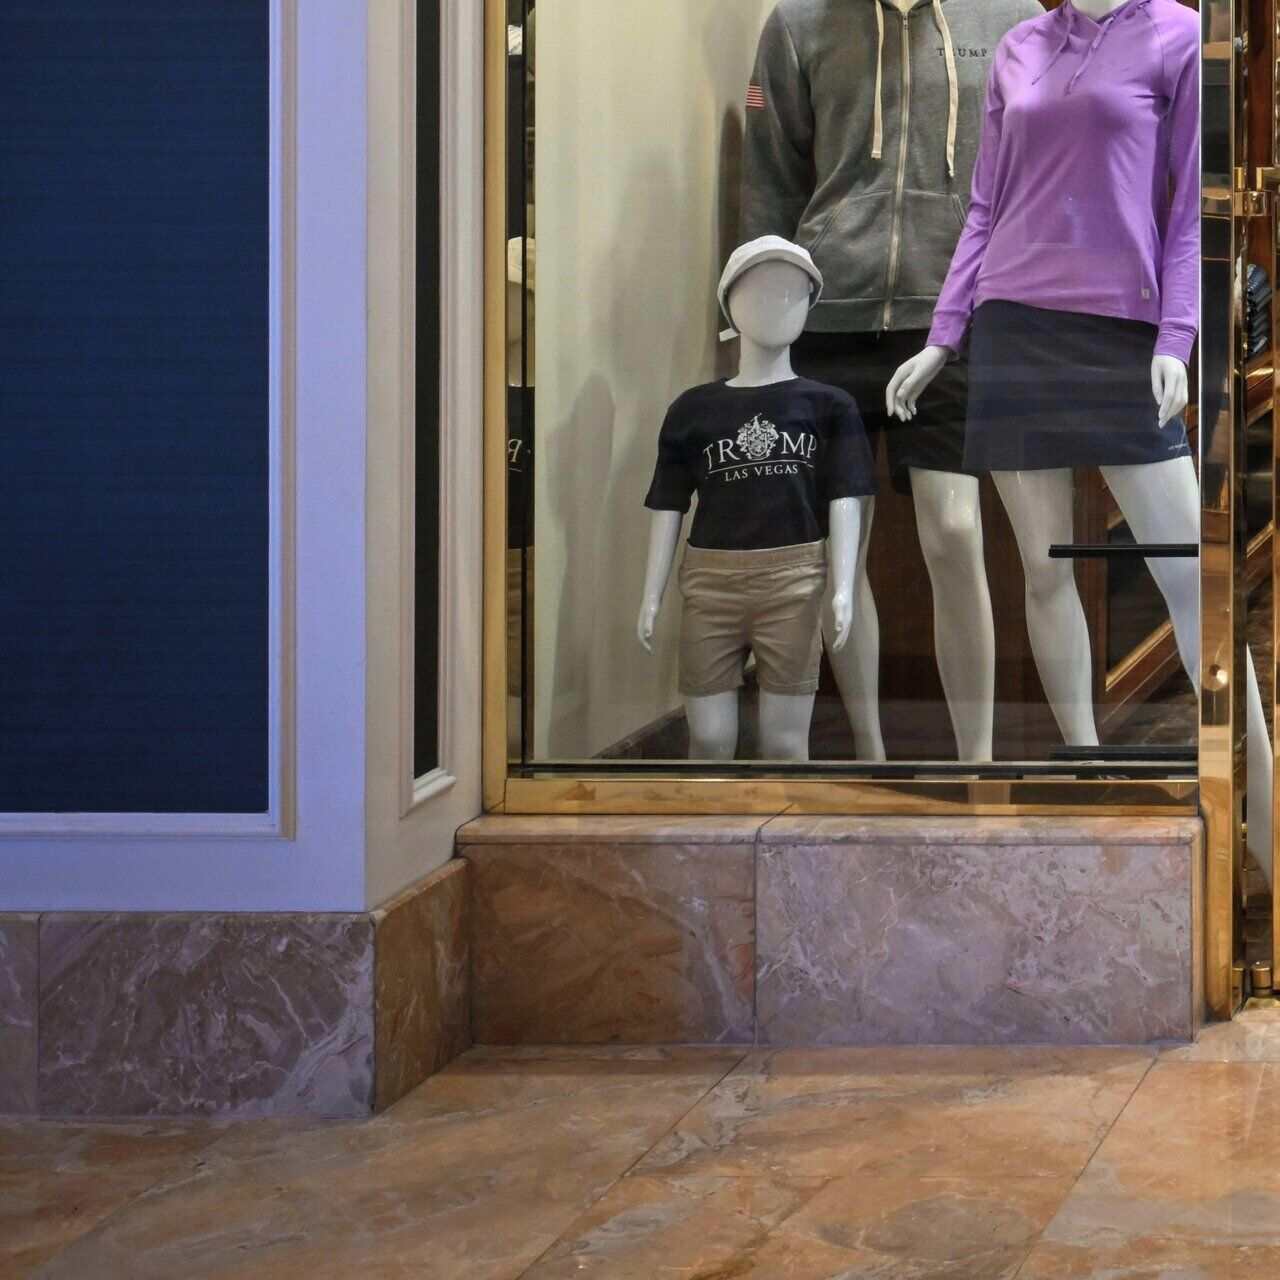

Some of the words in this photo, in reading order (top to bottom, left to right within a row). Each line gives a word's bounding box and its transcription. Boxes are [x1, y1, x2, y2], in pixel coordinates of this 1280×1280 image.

[936, 47, 988, 58] TUMP
[725, 468, 749, 482] LAS
[754, 464, 799, 478] VEGAS
